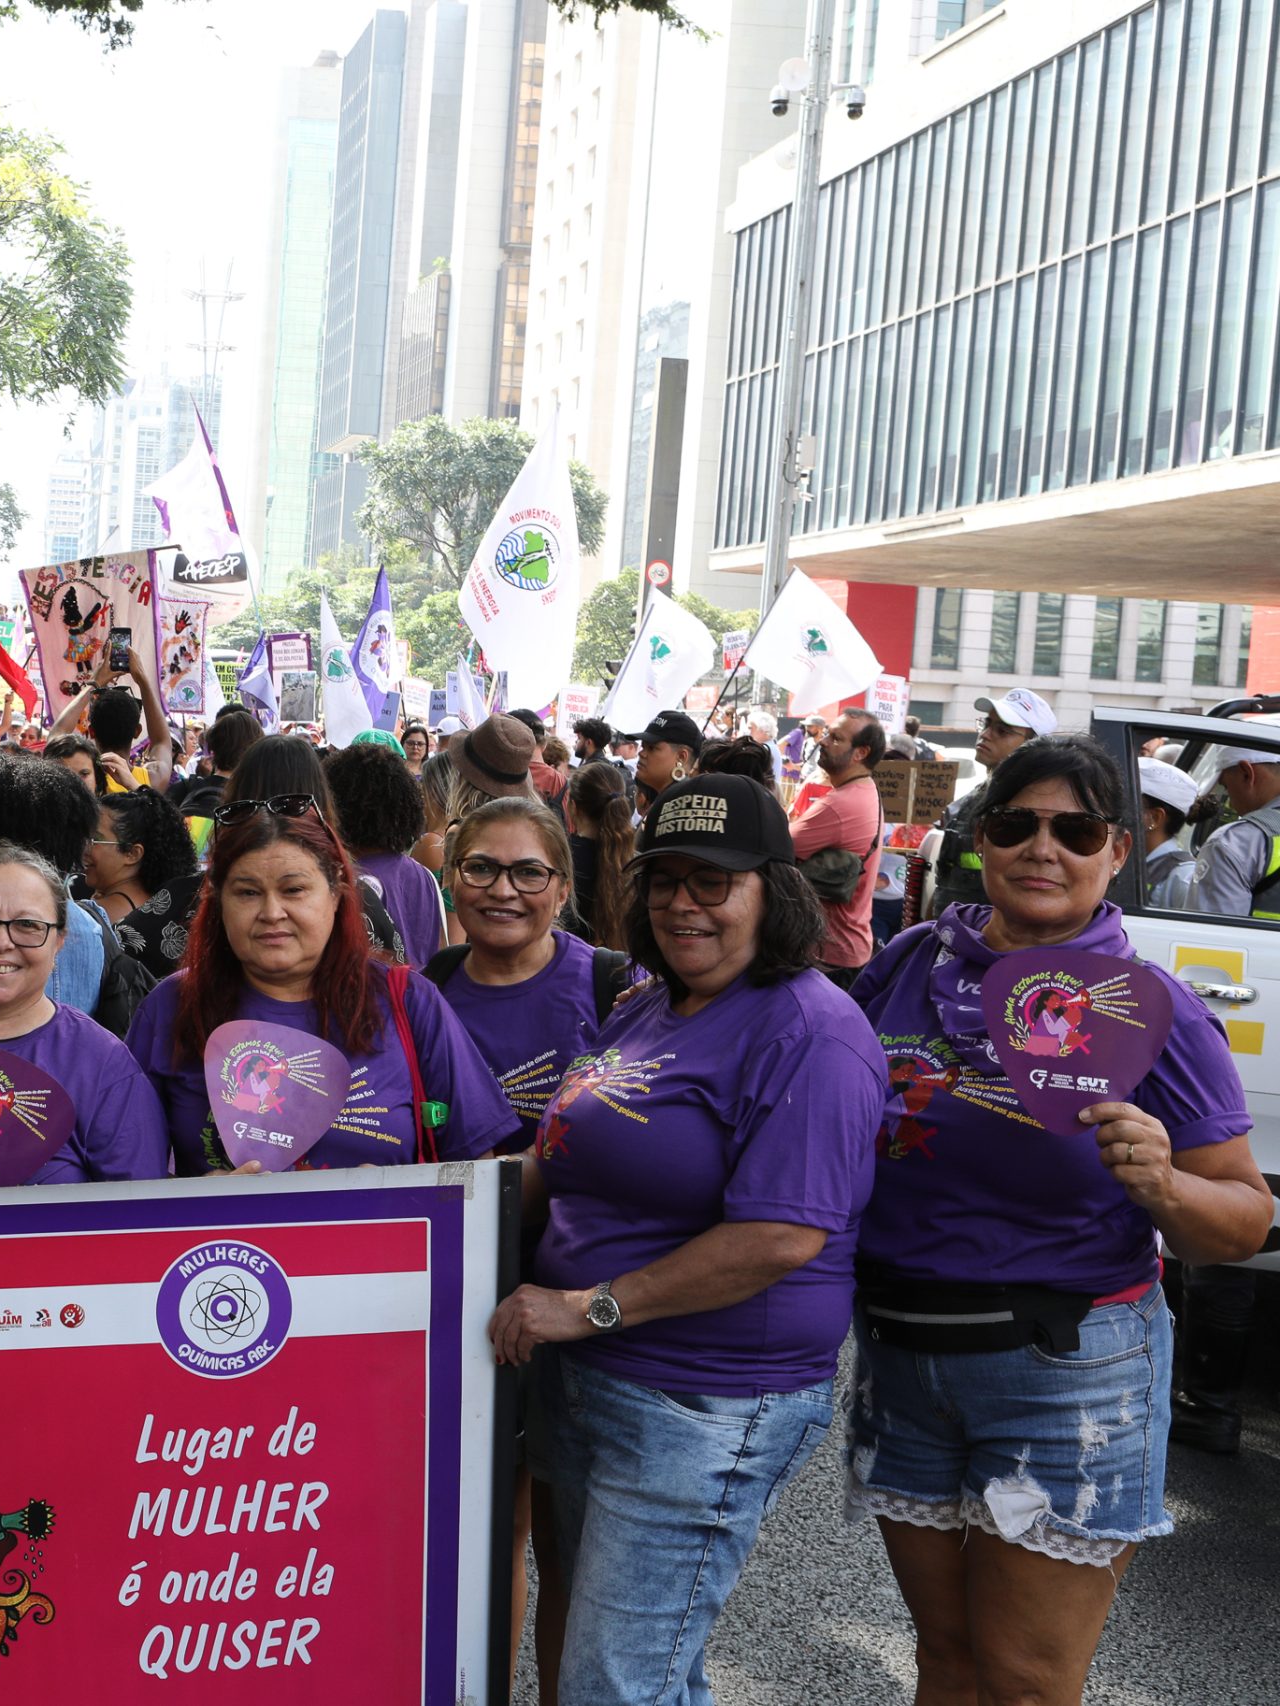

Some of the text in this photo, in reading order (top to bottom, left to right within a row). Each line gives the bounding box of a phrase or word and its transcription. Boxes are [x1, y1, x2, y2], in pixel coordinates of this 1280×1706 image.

[509, 508, 550, 525] MOVIMENTO
[879, 702, 892, 712] PARA
[661, 794, 728, 815] RESPEITA
[655, 816, 725, 837] HISTÓRIA
[1004, 997, 1016, 1025] Ainda
[1013, 971, 1051, 995] Estamos
[1018, 981, 1076, 1008] Mulheres luta por
[230, 1039, 261, 1058] Estamos
[534, 1048, 558, 1064] direitos
[900, 1046, 944, 1070] na luta por
[528, 1062, 554, 1078] decente
[502, 1077, 549, 1094] Fim jornada
[956, 1085, 1019, 1106] Justiça climática
[963, 1081, 990, 1091] Justiça
[510, 1092, 532, 1101] Justiça
[950, 1089, 1008, 1115] Sem anistia aos
[350, 1106, 389, 1114] reprodutiva
[619, 1104, 649, 1124] golpistas
[338, 1123, 364, 1135] anistia
[349, 1116, 381, 1126] climática
[277, 1141, 293, 1149] PAULO
[178, 1246, 270, 1278] MULHERES
[178, 1339, 275, 1371] QUÍMICAS ABC
[135, 1405, 317, 1476] Lugar de
[128, 1479, 330, 1540] MULHER
[118, 1547, 335, 1607] é onde ela
[139, 1617, 321, 1680] QUISER
